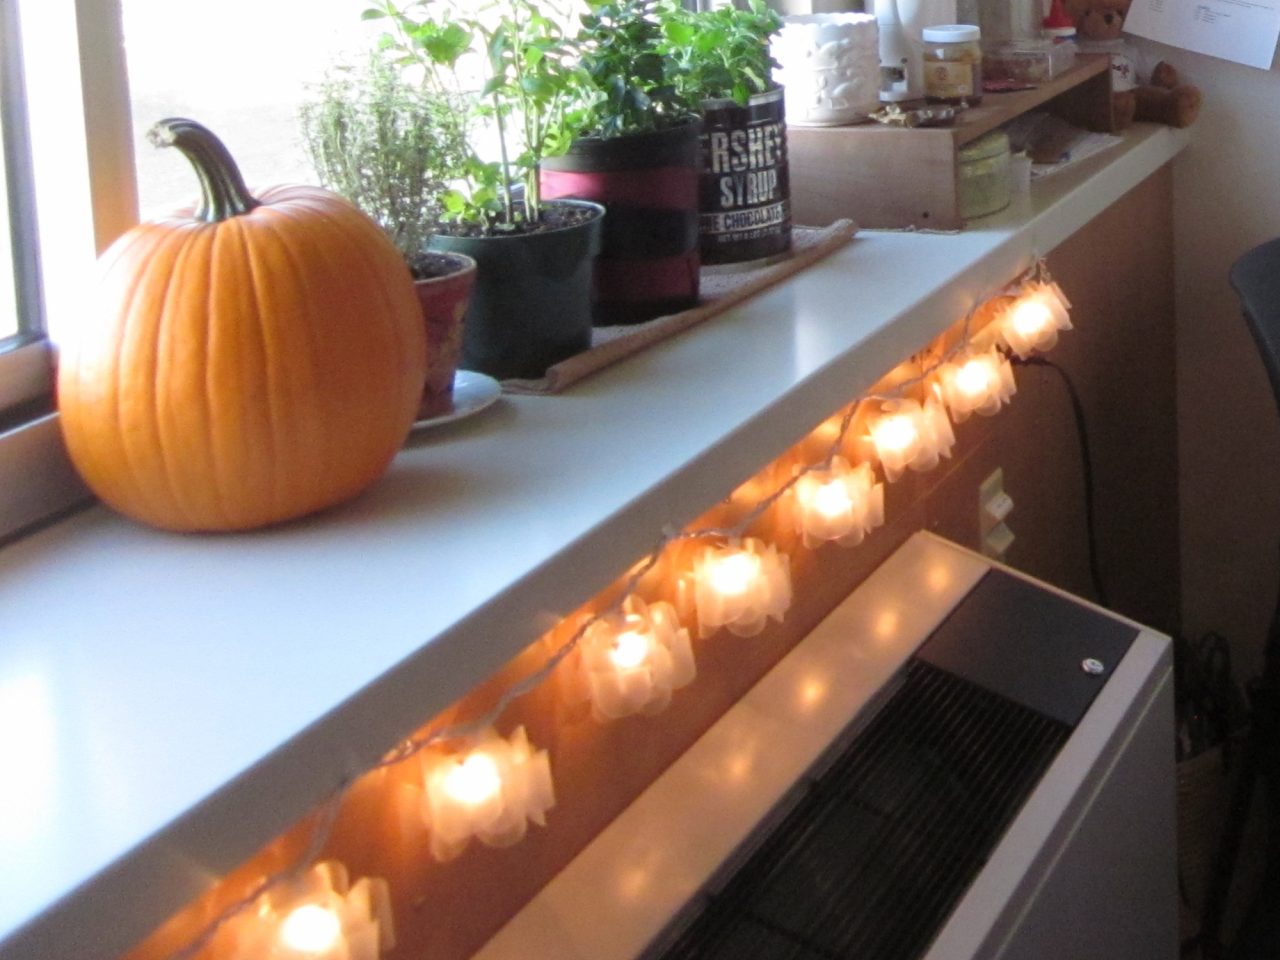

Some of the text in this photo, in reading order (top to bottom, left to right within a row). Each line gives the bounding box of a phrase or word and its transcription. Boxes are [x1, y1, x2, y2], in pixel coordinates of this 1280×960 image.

[698, 123, 784, 174] ERSHEY
[720, 169, 778, 209] SYRUP
[724, 205, 783, 231] CHOCOLATE
